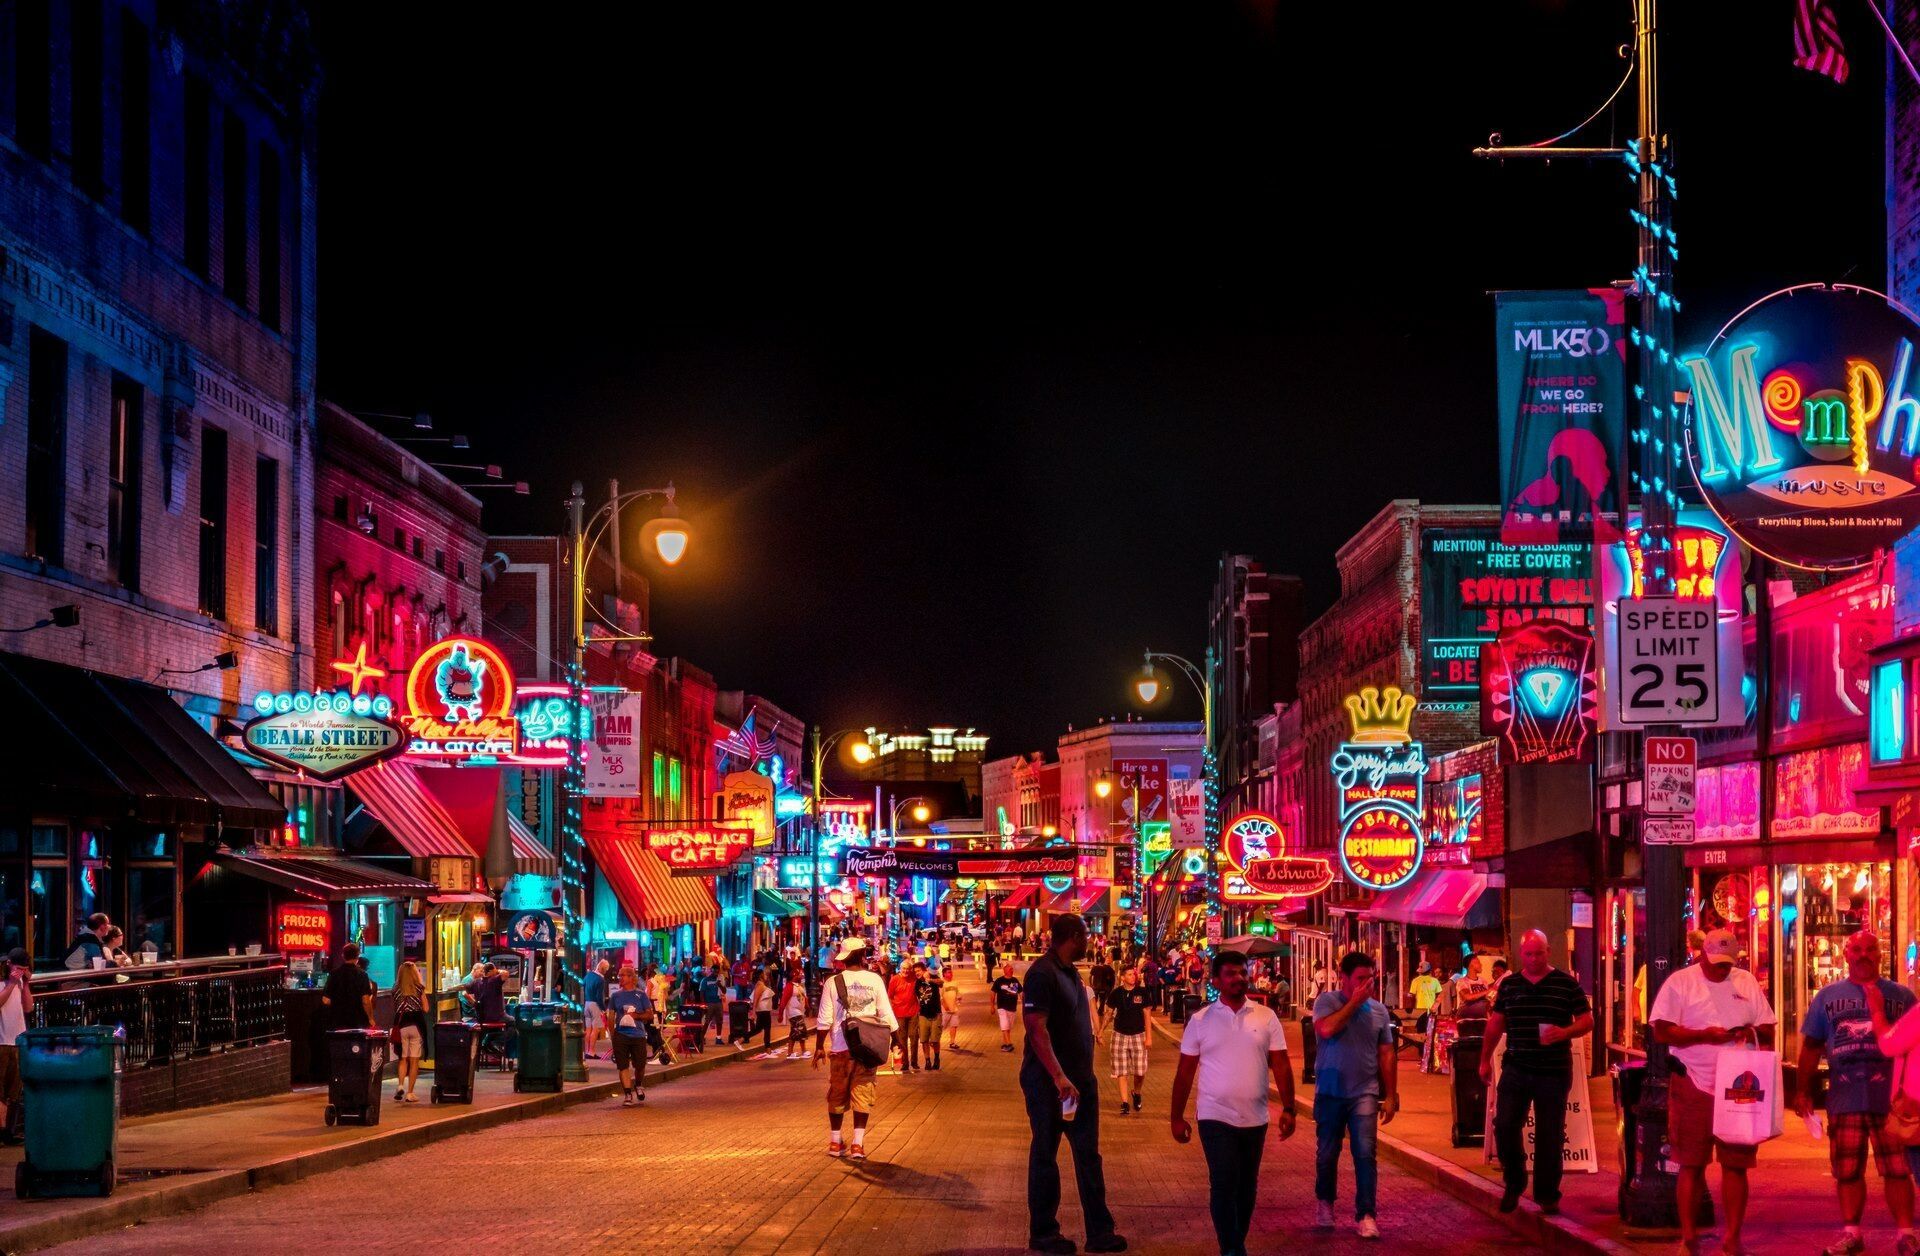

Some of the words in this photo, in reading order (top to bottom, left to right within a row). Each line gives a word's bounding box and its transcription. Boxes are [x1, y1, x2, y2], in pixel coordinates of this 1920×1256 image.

[1514, 327, 1610, 358] MLK50
[1527, 377, 1575, 387] WHERE
[1578, 376, 1597, 386] DO
[1540, 390, 1561, 400] WE
[1565, 389, 1585, 400] GO
[1522, 405, 1559, 414] FROM
[1563, 403, 1604, 413] HERE?
[1759, 517, 1801, 527] Everything
[1804, 517, 1828, 526] Blues,
[1830, 517, 1847, 526] Soul
[1849, 517, 1856, 526] &
[1433, 540, 1486, 552] MENTION
[1487, 554, 1521, 568] FREE
[1525, 554, 1572, 568] COVER
[1460, 575, 1543, 603] COYOTE
[1627, 611, 1709, 630] SPEED
[1636, 638, 1700, 656] LIMIT
[1630, 663, 1709, 709] 25
[1416, 703, 1465, 711] LAMAR
[299, 719, 324, 728] World
[326, 720, 355, 728] Famous
[606, 716, 632, 733] AM
[255, 729, 314, 745] BEALE
[321, 729, 391, 745] STREET
[1547, 748, 1576, 763] BEALE
[1656, 743, 1685, 759] NO
[602, 756, 623, 765] MLK
[609, 765, 623, 775] 50
[1651, 767, 1689, 777] PARKING
[1348, 790, 1372, 799] HALL
[1376, 790, 1387, 798] OF
[1390, 790, 1416, 798] FAME
[1678, 795, 1690, 806] TN
[1364, 811, 1400, 829] BAR
[1232, 820, 1277, 837] PIG
[694, 832, 748, 845] PALACE
[670, 847, 726, 862] CAFE
[1345, 838, 1416, 857] RESTAURANT
[1704, 850, 1727, 864] ENTER
[846, 855, 898, 876] Memphis
[900, 861, 954, 871] WELCOMES
[1005, 856, 1075, 874] AutoZone
[1352, 861, 1370, 879] 159
[1374, 860, 1413, 885] BEALE
[786, 893, 803, 901] JUKE
[283, 915, 327, 928] FROZEN
[283, 933, 325, 947] DRINKS
[1563, 1149, 1589, 1161] Roll
